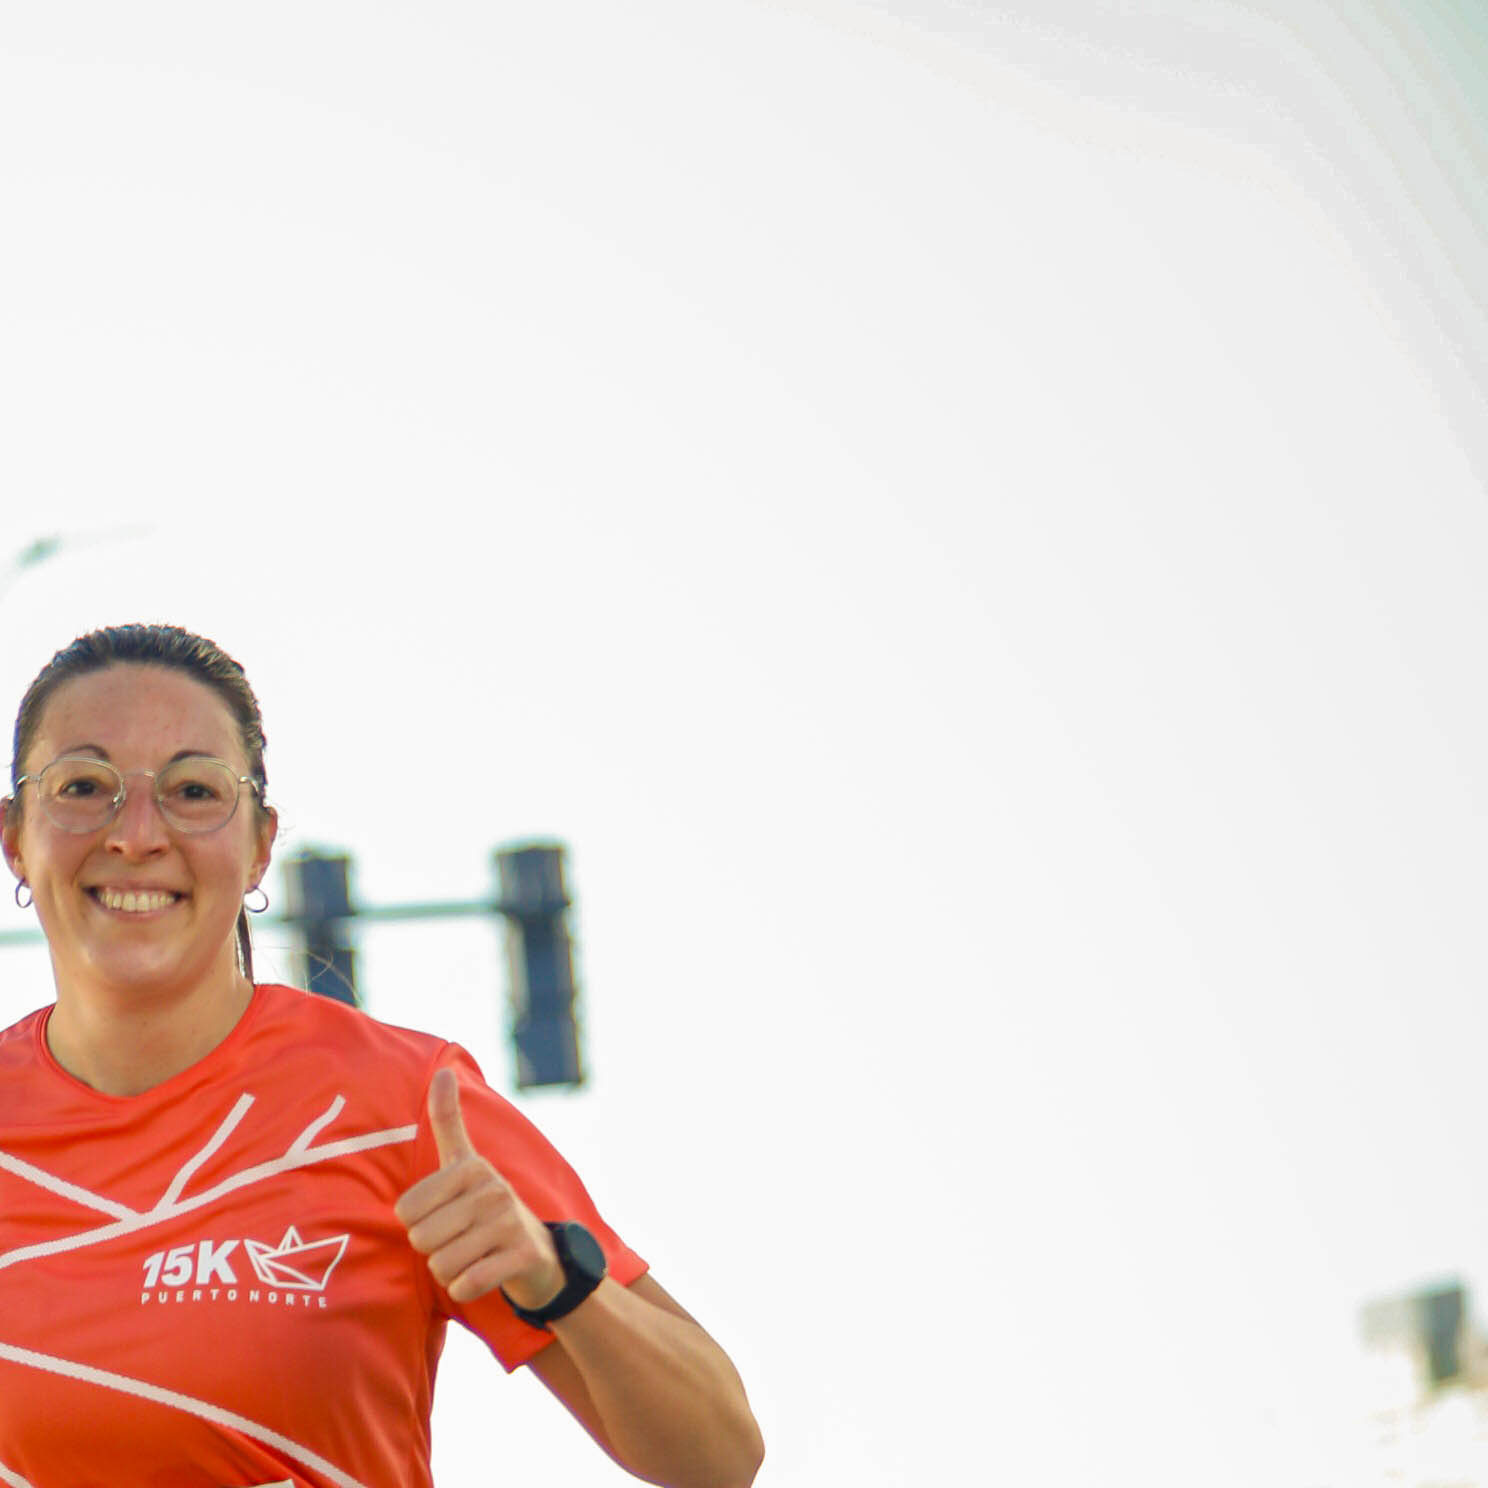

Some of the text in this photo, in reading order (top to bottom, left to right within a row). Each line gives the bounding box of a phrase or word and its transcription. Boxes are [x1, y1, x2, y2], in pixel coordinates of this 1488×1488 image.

[142, 1239, 241, 1289] 15K
[141, 1289, 327, 1309] PUERTO NORTE
